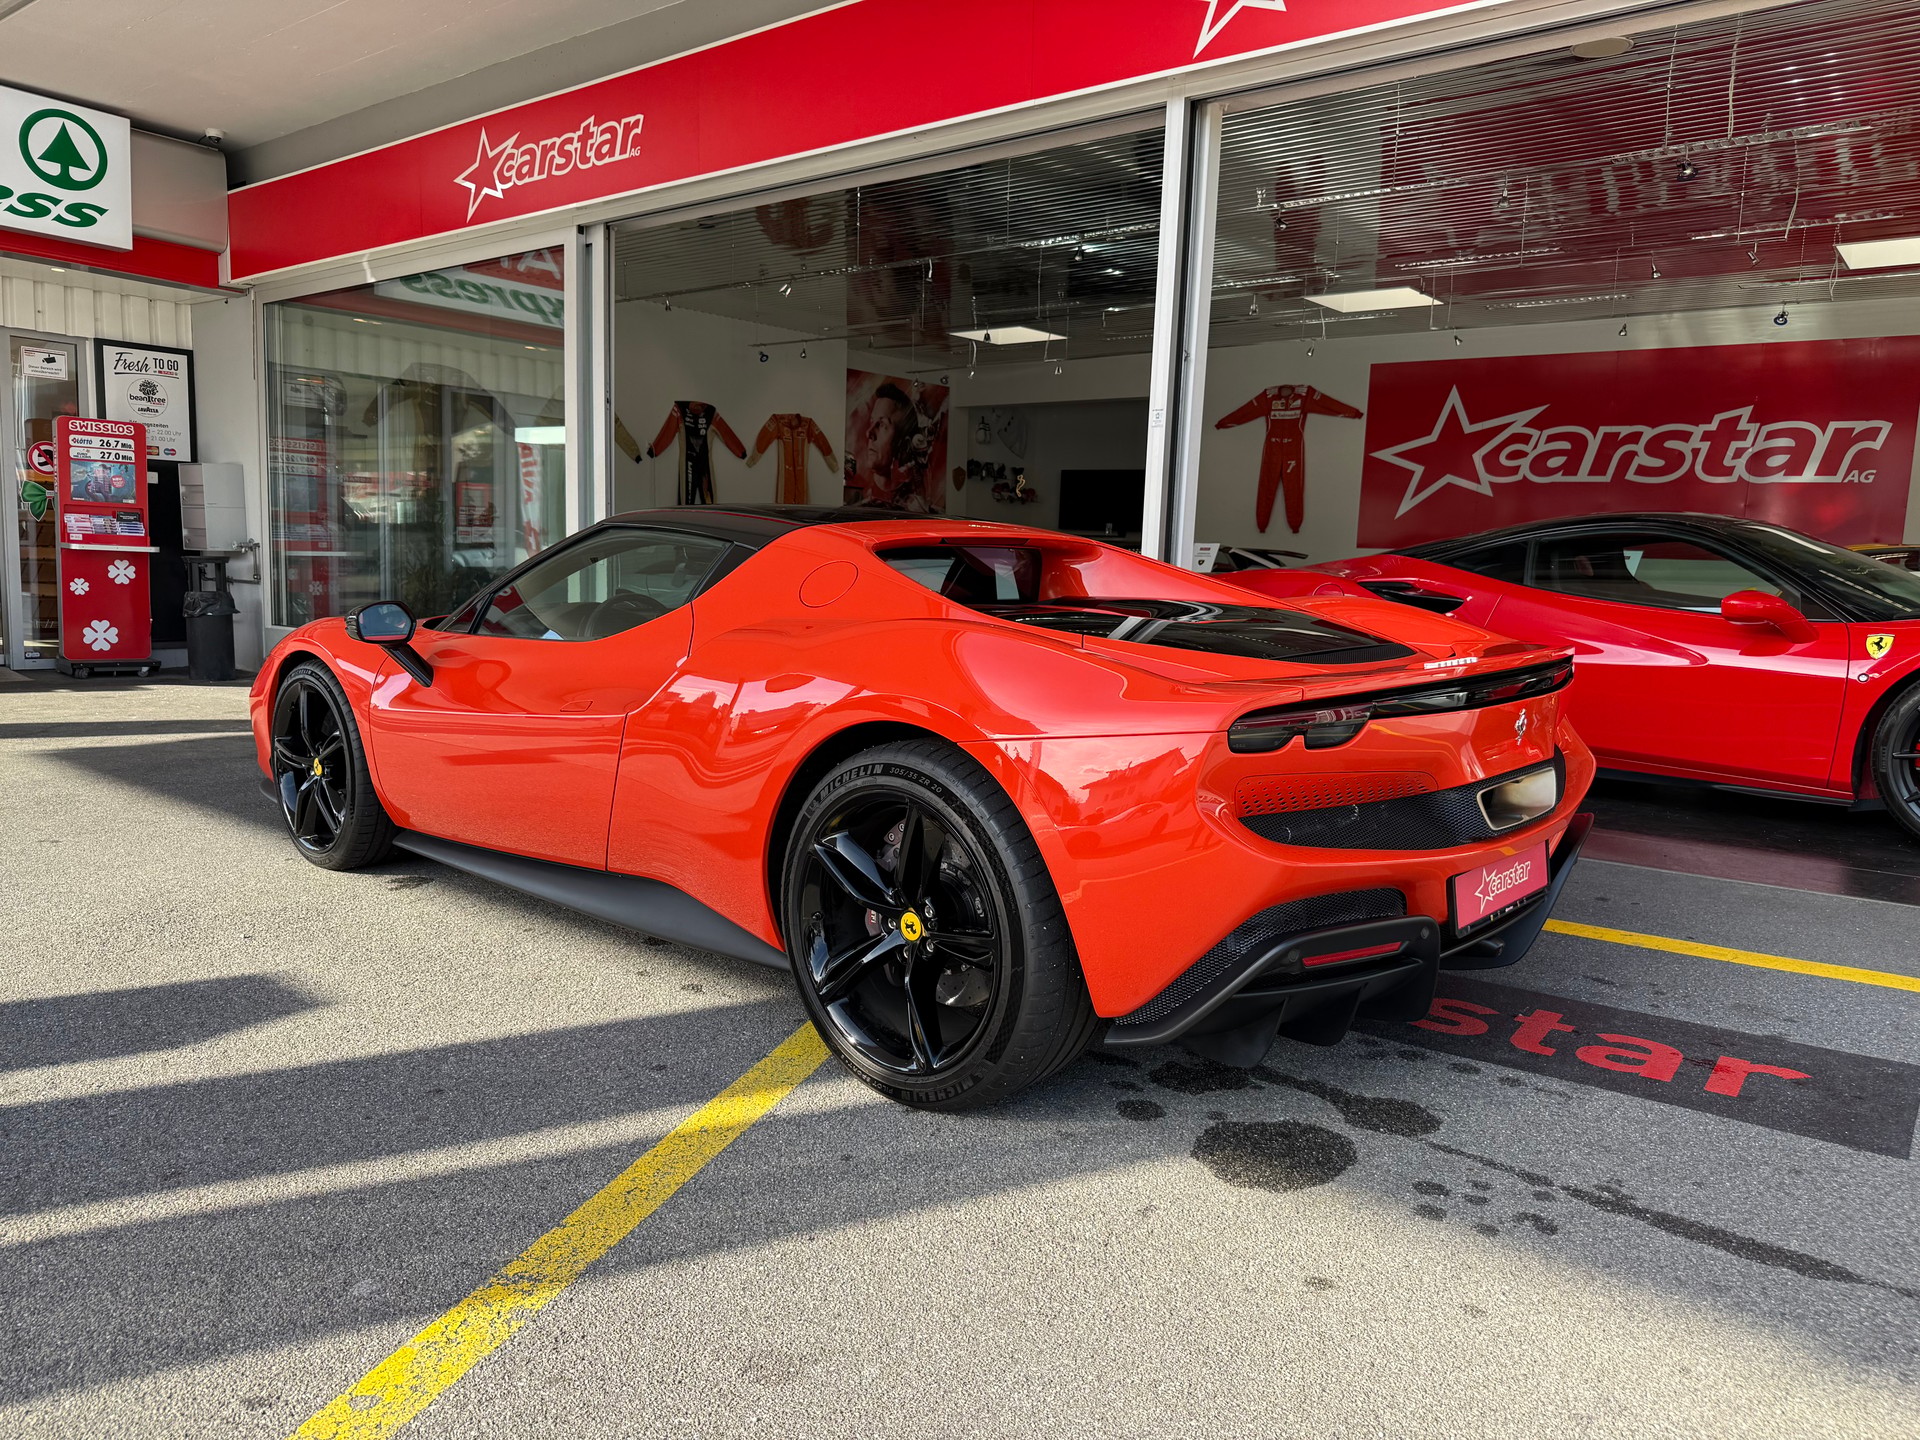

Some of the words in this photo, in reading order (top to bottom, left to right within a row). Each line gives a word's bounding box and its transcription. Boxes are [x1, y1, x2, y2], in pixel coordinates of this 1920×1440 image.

[498, 114, 644, 190] carstar
[629, 146, 641, 158] AG
[113, 352, 151, 373] Fresh
[152, 357, 165, 370] TO
[166, 359, 179, 371] GO
[69, 420, 134, 435] SWISSLOS
[1480, 405, 1893, 484] carstar
[1843, 469, 1877, 484] AG
[1286, 460, 1296, 473] 7
[820, 764, 884, 800] MICHELIN
[889, 766, 918, 781] 305/35
[918, 775, 931, 787] ZR
[930, 782, 943, 794] 20
[1489, 860, 1530, 896] carstar
[1407, 998, 1813, 1098] star
[900, 1077, 975, 1103] MICHELIN
